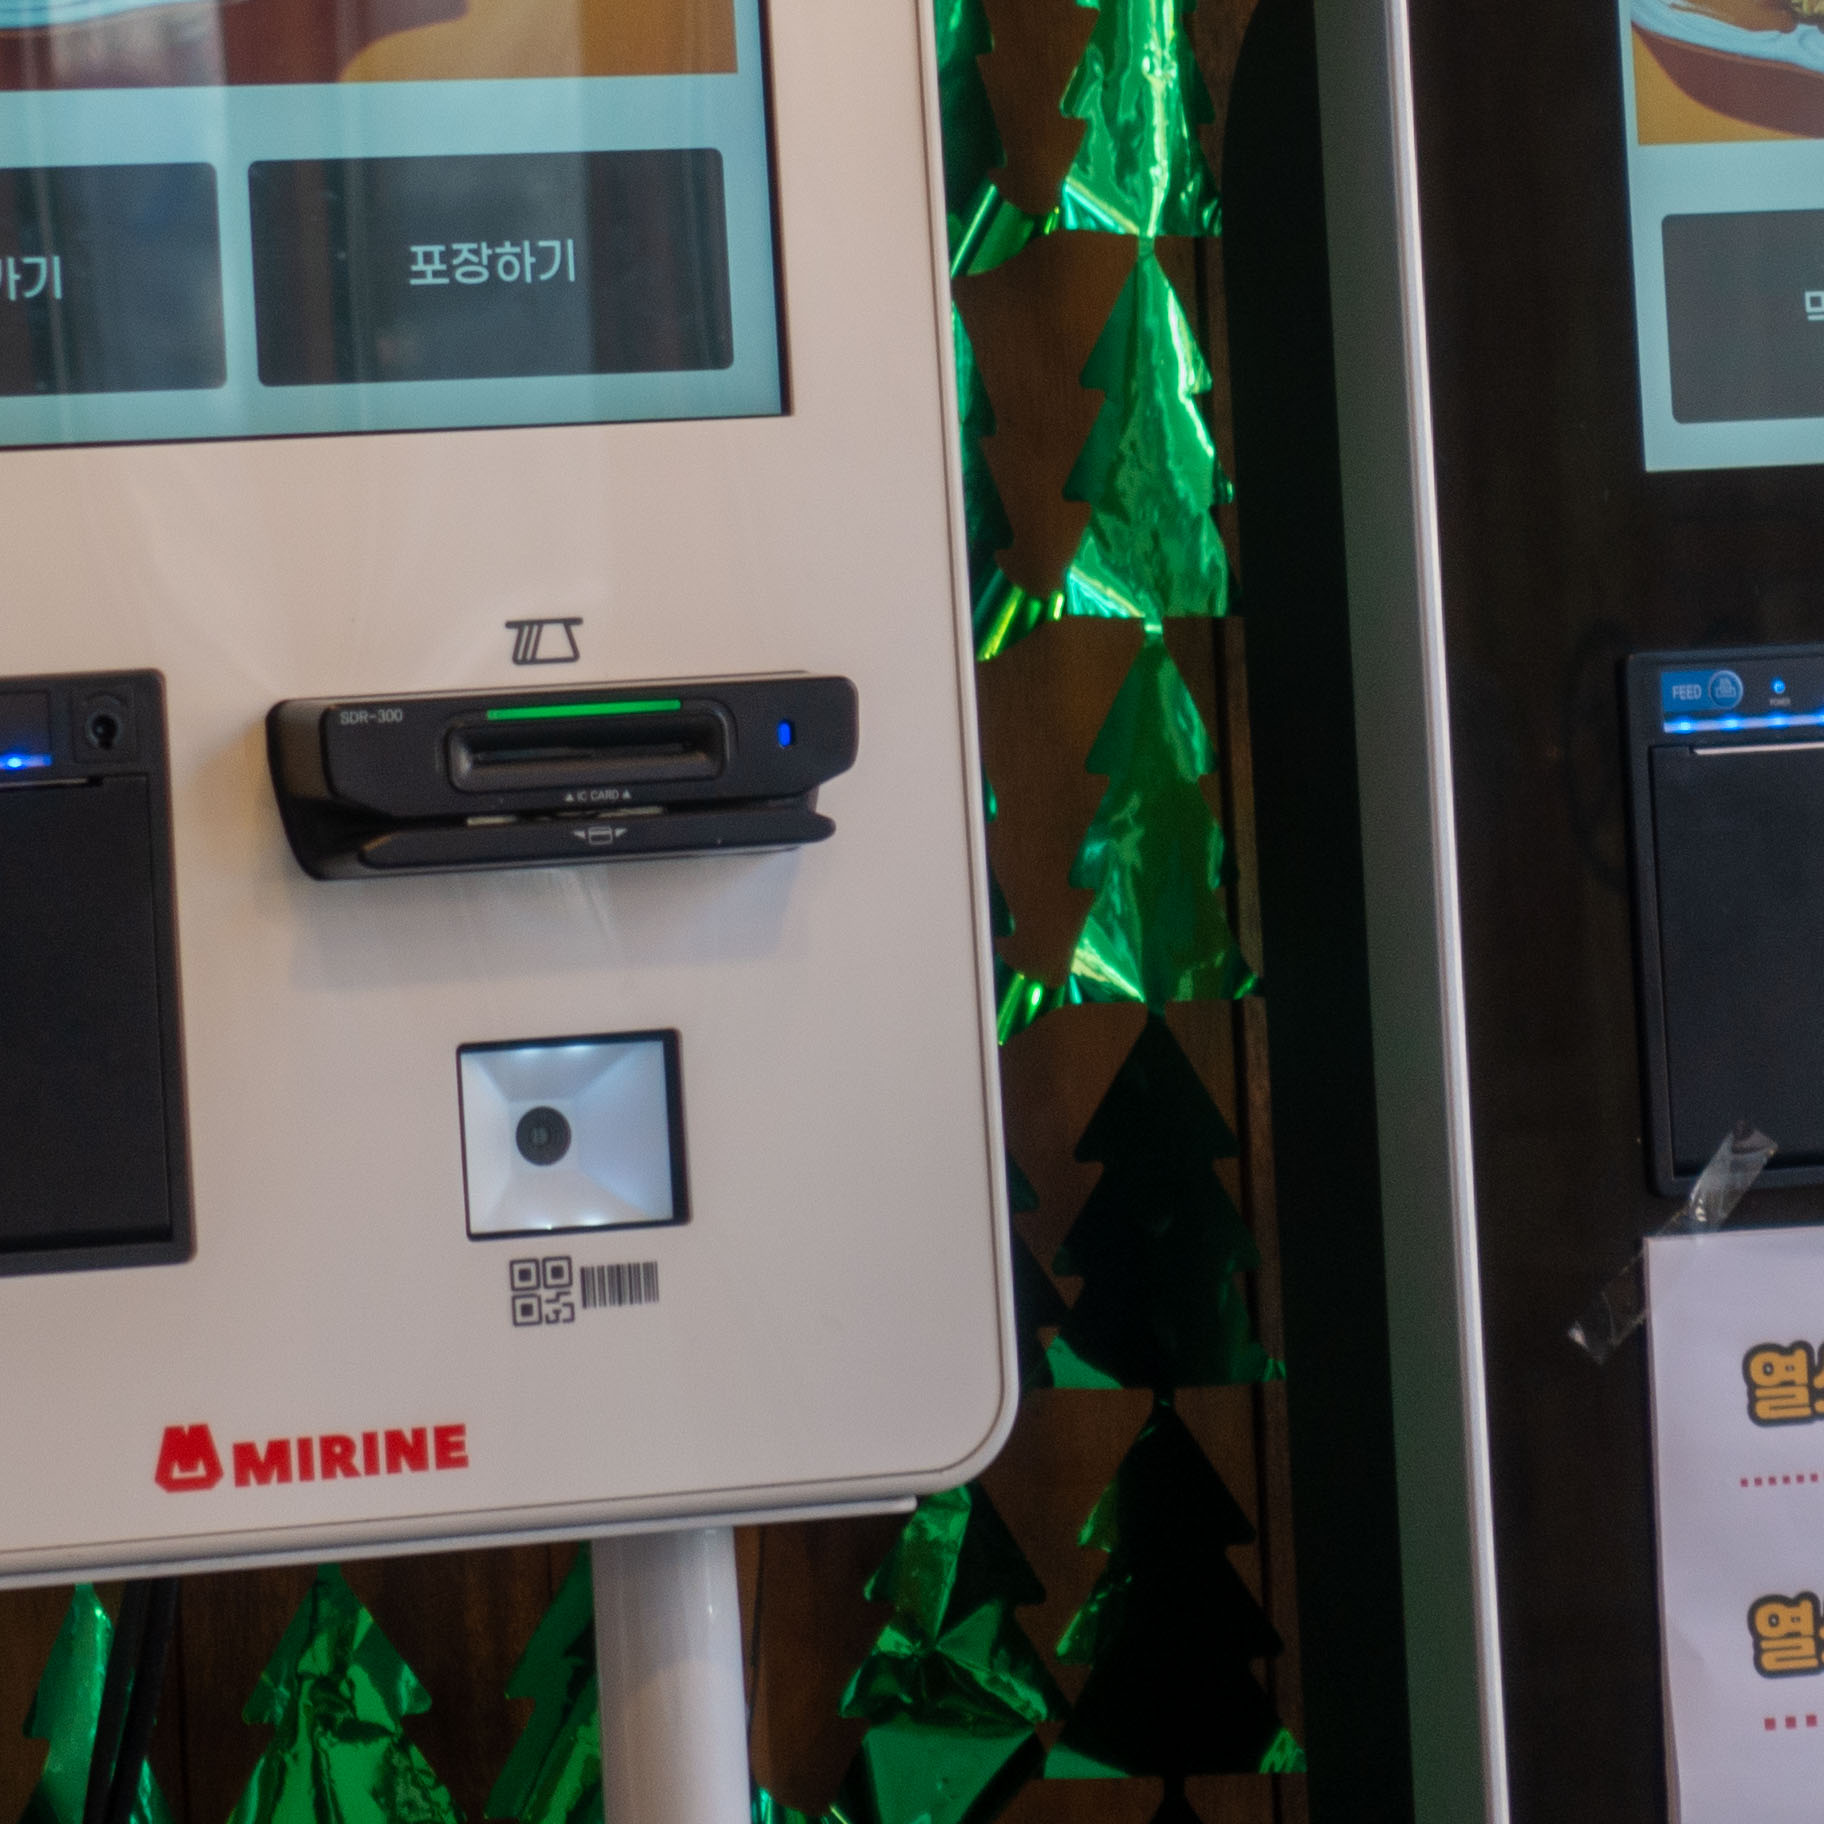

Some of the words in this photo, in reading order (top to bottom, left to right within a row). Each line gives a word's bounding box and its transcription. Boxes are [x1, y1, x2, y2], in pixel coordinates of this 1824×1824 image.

[408, 238, 577, 289] 포장하기
[1672, 684, 1702, 700] FEED
[232, 1423, 471, 1488] MIRINE
